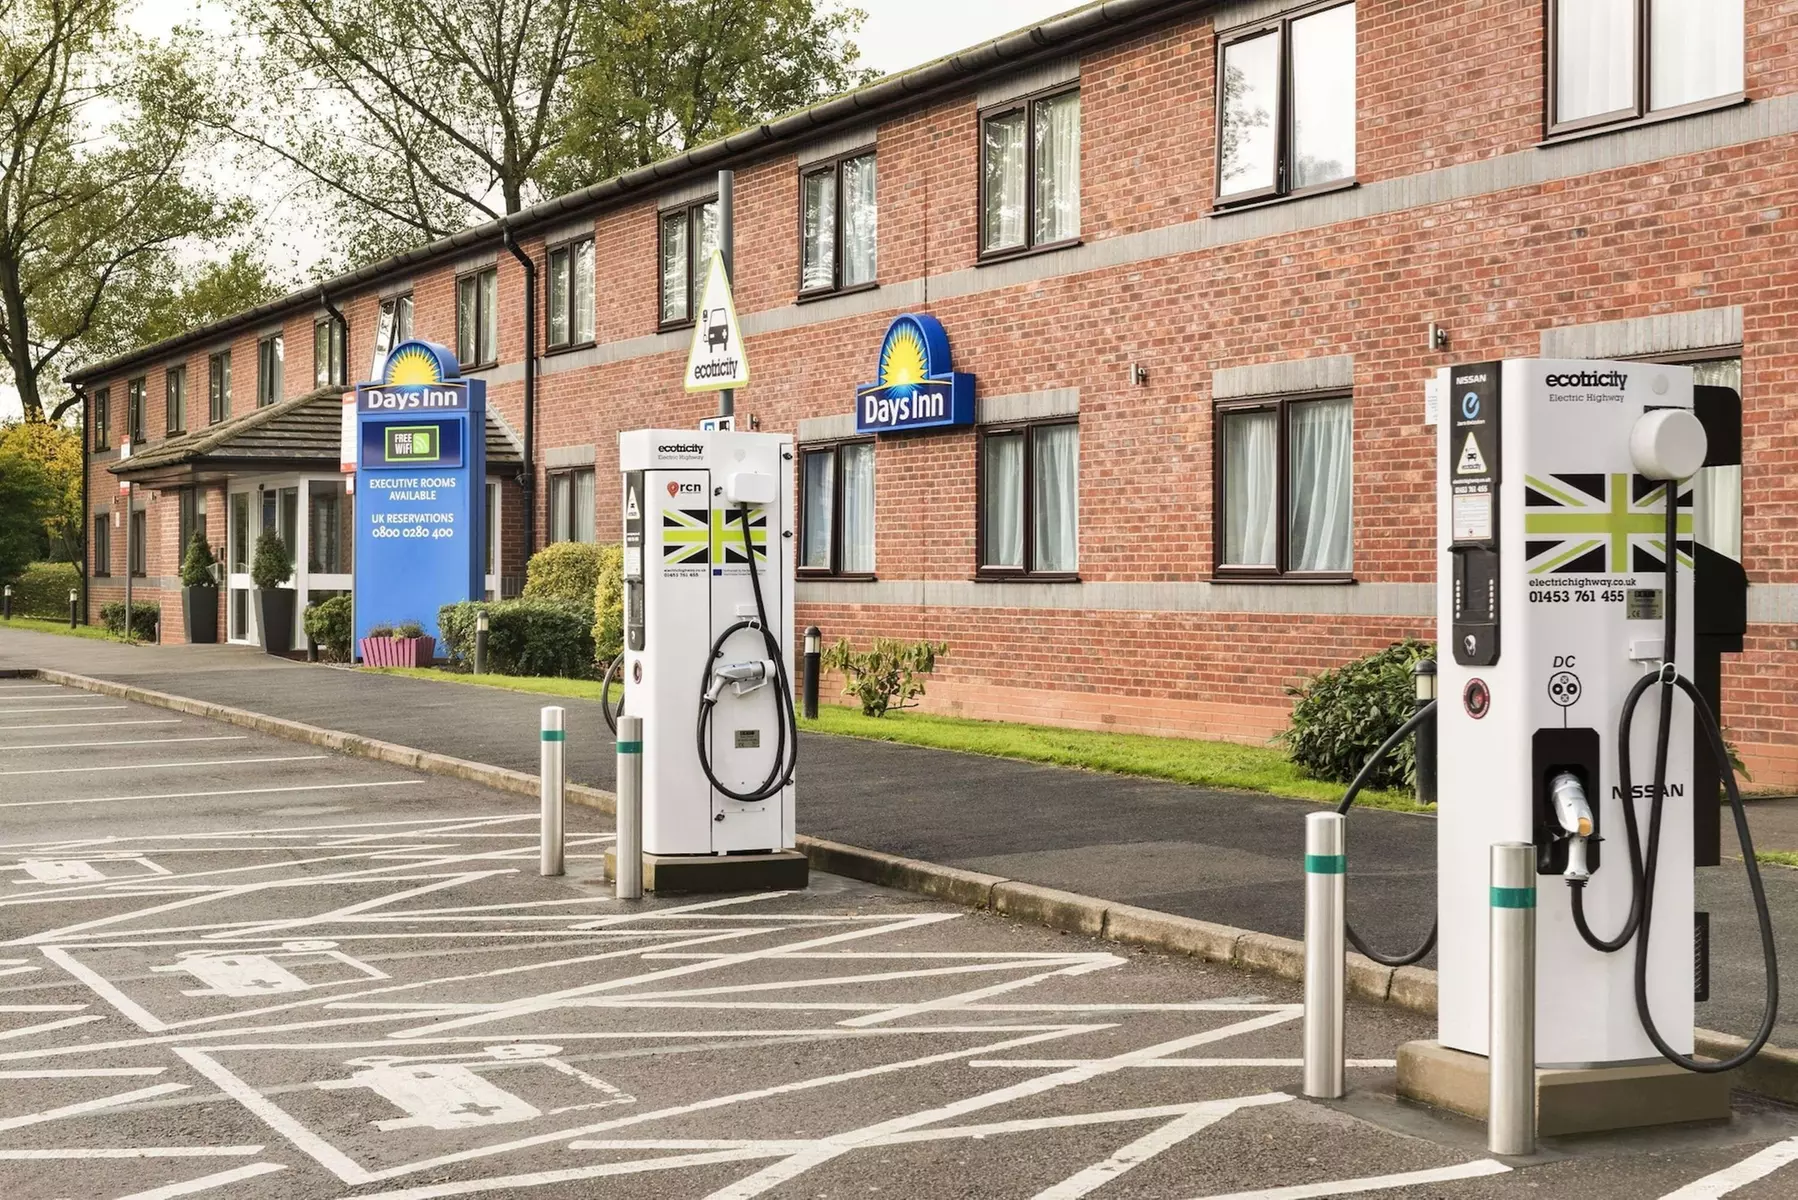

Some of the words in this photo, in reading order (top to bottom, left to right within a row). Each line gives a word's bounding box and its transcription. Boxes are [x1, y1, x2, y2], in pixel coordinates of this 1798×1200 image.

[694, 358, 738, 380] ecotricity
[1456, 374, 1487, 385] NISSAN
[1545, 371, 1628, 391] ecotricity
[368, 389, 420, 410] Days
[422, 388, 458, 407] Inn
[1549, 393, 1584, 402] Electric
[1586, 393, 1625, 403] Highway
[865, 395, 910, 426] Days
[912, 390, 944, 419] Inn
[394, 433, 412, 443] FREE
[658, 443, 704, 454] ecotricity
[369, 478, 418, 489] EXECUTIVE
[420, 477, 456, 488] ROOMS
[680, 483, 702, 492] rcn
[389, 490, 437, 501] AVAILABLE
[371, 514, 385, 524] UK
[386, 512, 454, 524] RESERVATIONS
[372, 525, 401, 538] 0800
[402, 525, 430, 538] 0280
[431, 528, 454, 540] 400
[1529, 578, 1637, 588] electrichighway.co.uk
[1529, 590, 1570, 603] 01453
[1574, 590, 1595, 602] 761
[1601, 590, 1625, 602] 455
[1552, 655, 1576, 668] DC
[1612, 783, 1684, 800] NSSAN
